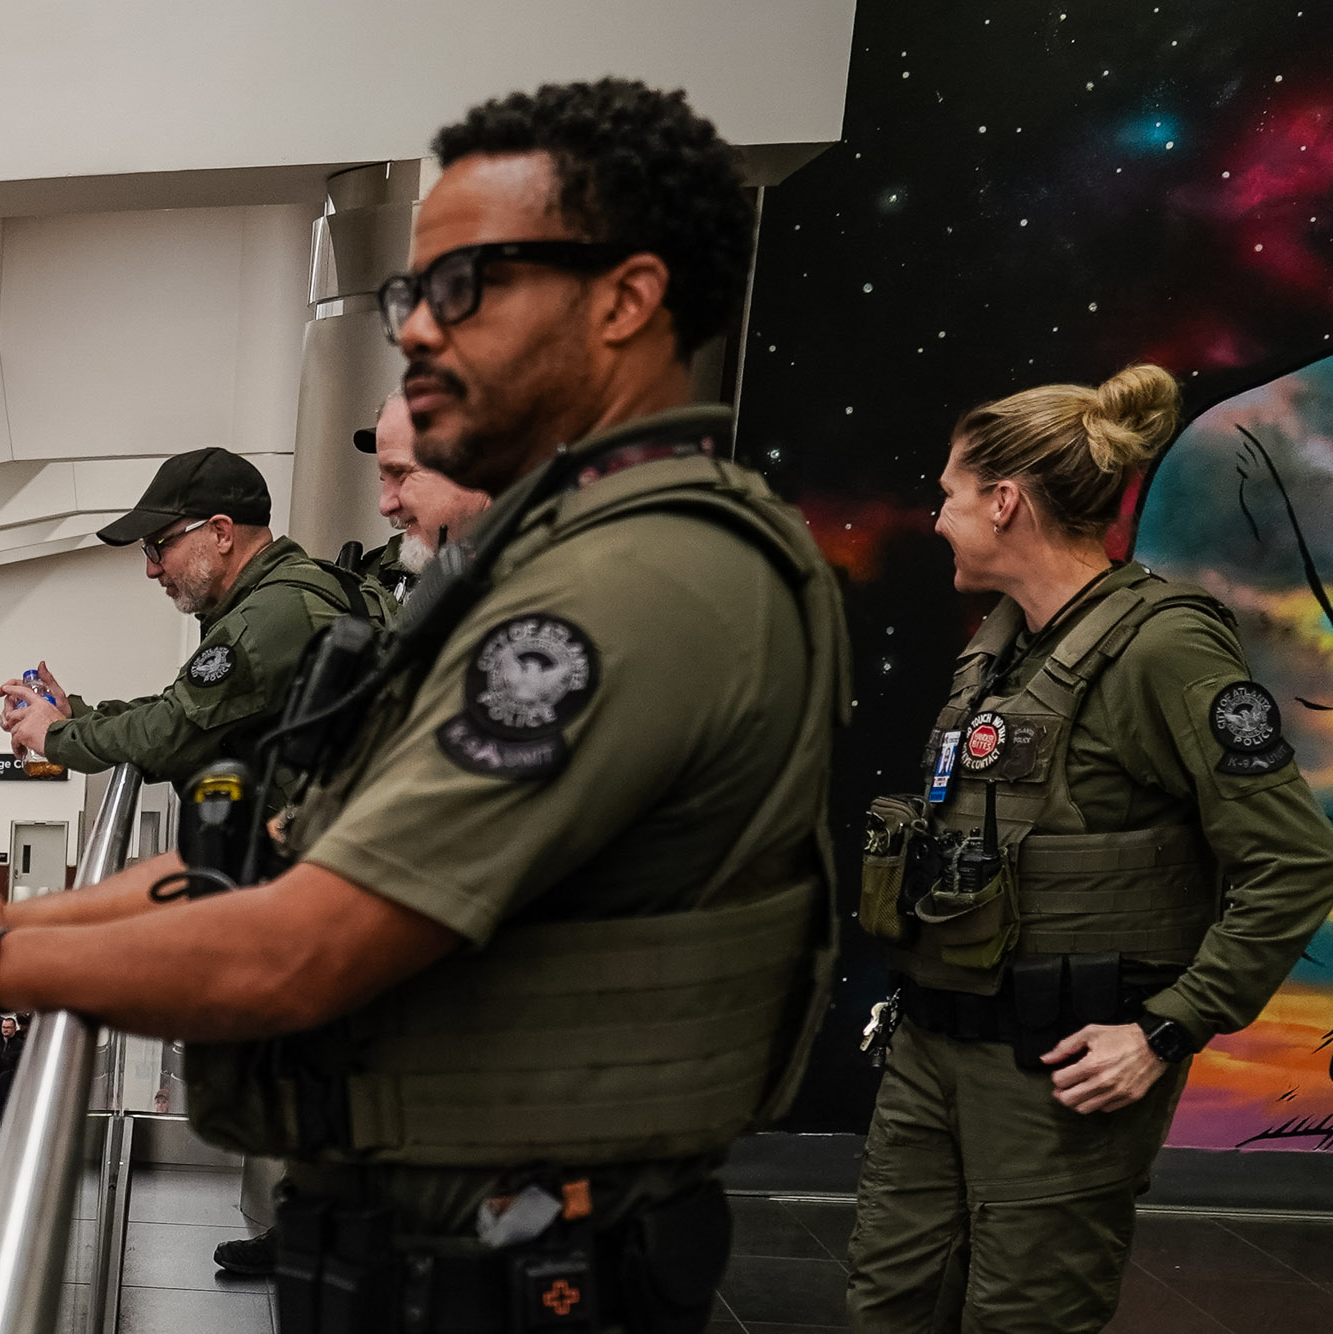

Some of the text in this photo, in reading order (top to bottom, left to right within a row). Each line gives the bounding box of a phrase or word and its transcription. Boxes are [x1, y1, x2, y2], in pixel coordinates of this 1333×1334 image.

[1220, 693, 1232, 707] OF
[971, 713, 993, 727] TOUCH
[1216, 707, 1226, 730] CITY
[1233, 726, 1273, 746] POLICE
